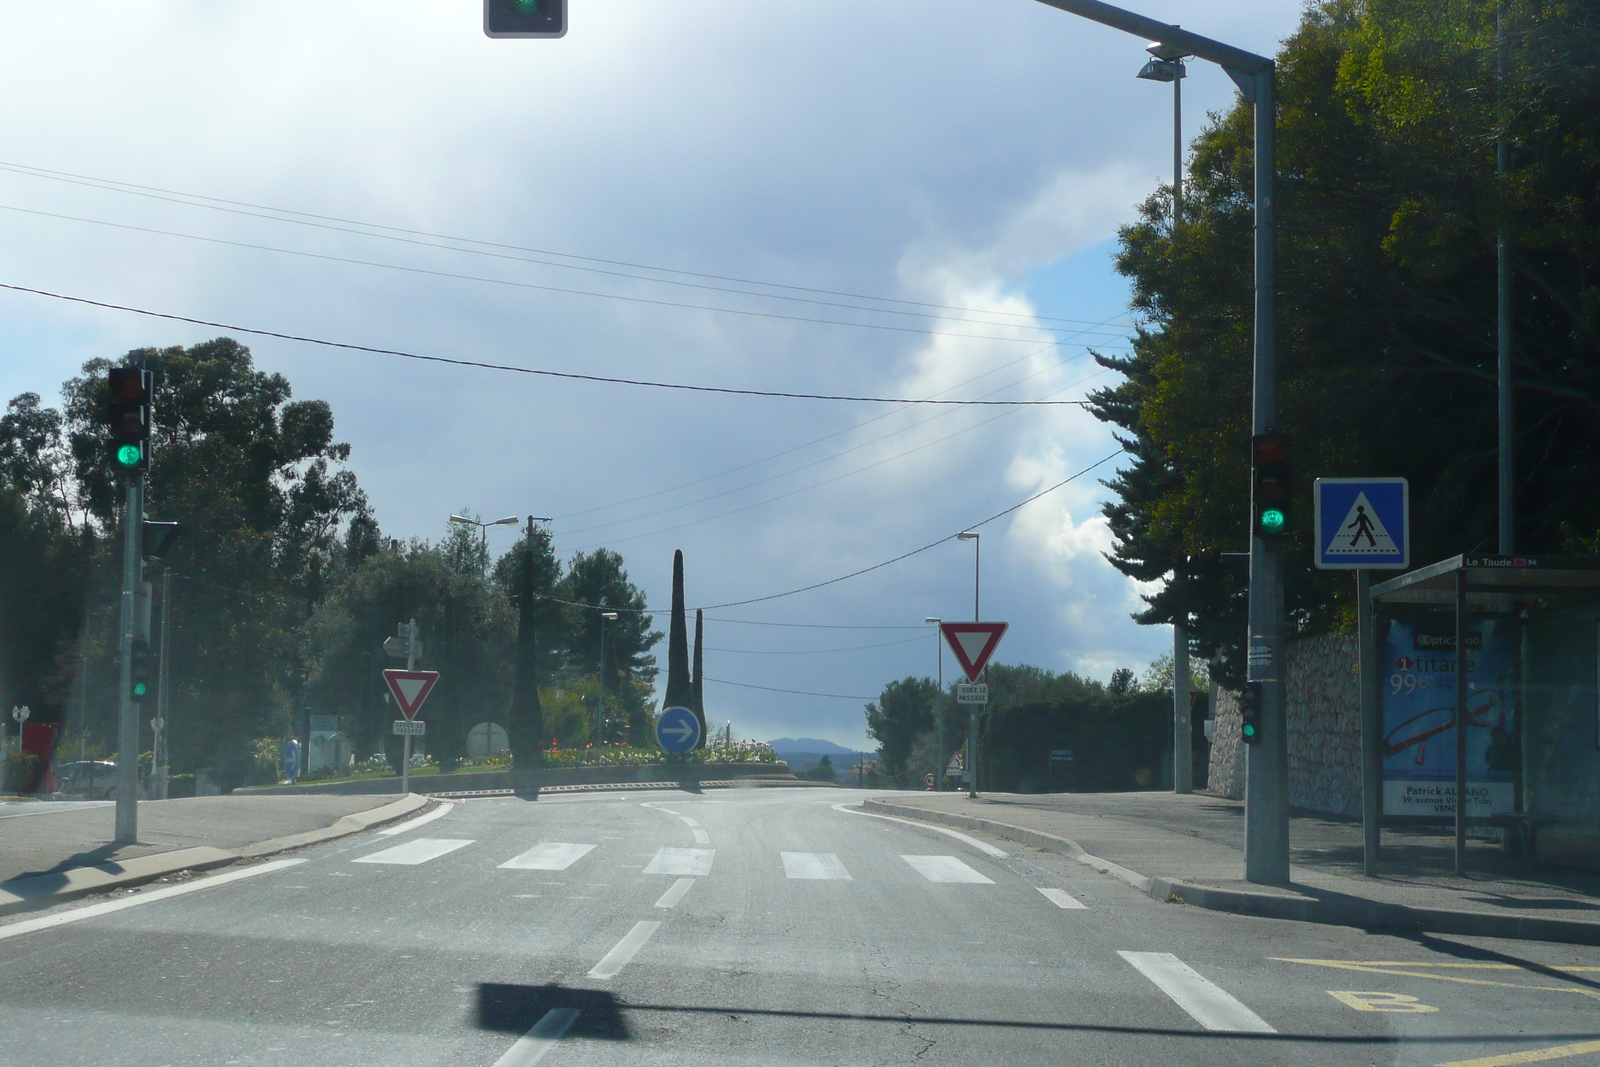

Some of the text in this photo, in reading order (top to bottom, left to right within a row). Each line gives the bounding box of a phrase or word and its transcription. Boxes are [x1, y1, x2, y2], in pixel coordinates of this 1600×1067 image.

[1466, 558, 1478, 566] Le
[1482, 558, 1512, 567] Taude
[1423, 635, 1452, 647] Optic
[1406, 786, 1489, 796] Patrick ALANO
[1473, 797, 1494, 806] Tuby
[1325, 990, 1439, 1013] B
